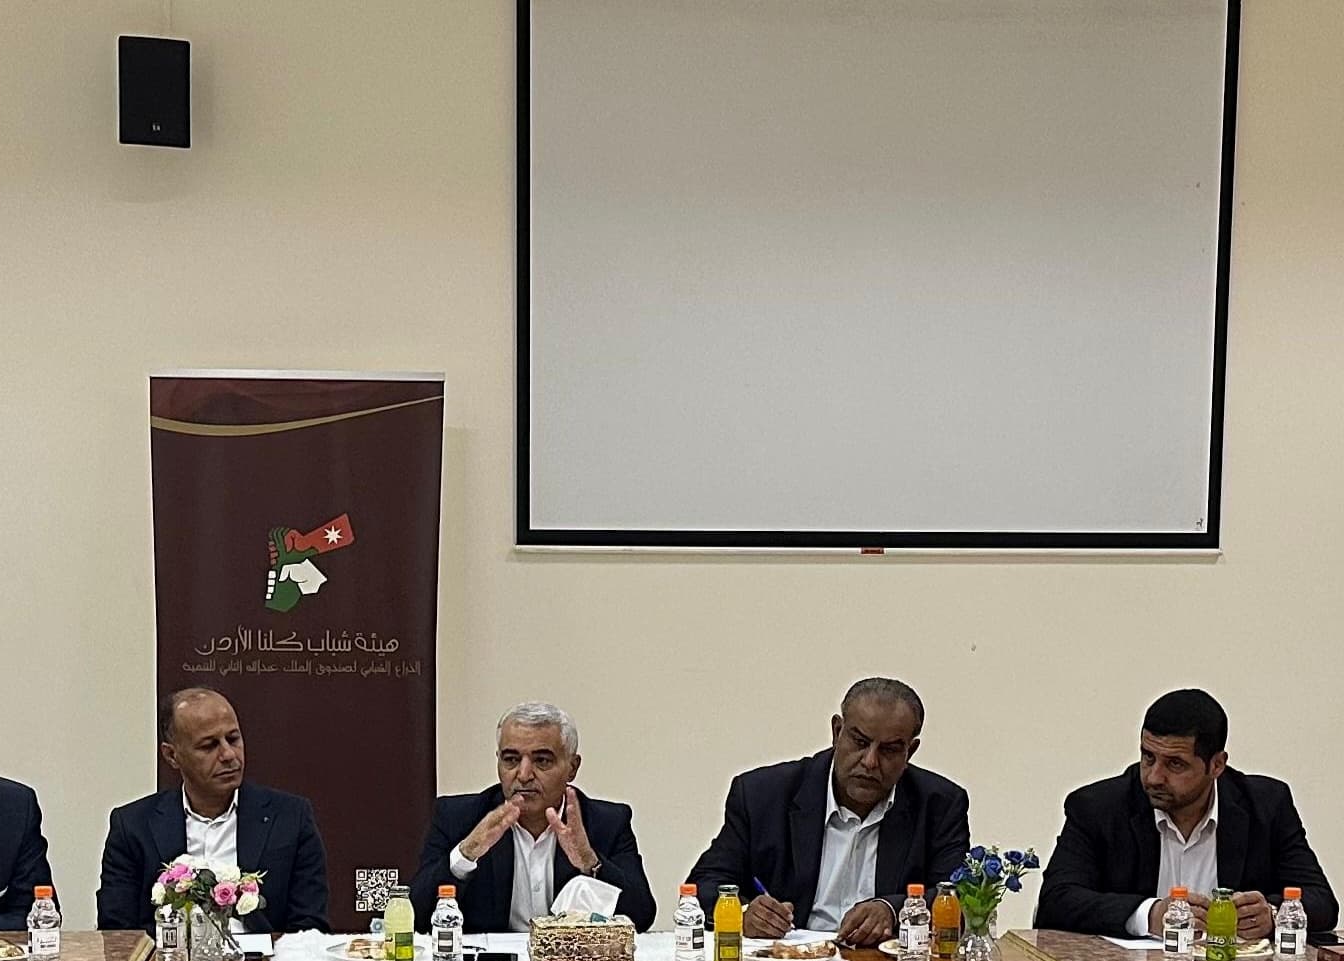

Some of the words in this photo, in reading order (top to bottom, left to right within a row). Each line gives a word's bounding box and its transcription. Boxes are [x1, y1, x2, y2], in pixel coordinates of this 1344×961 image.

[194, 624, 253, 657] الأردن
[258, 629, 304, 653] كلنا
[307, 629, 353, 657] شباب
[355, 631, 400, 656] هيئة
